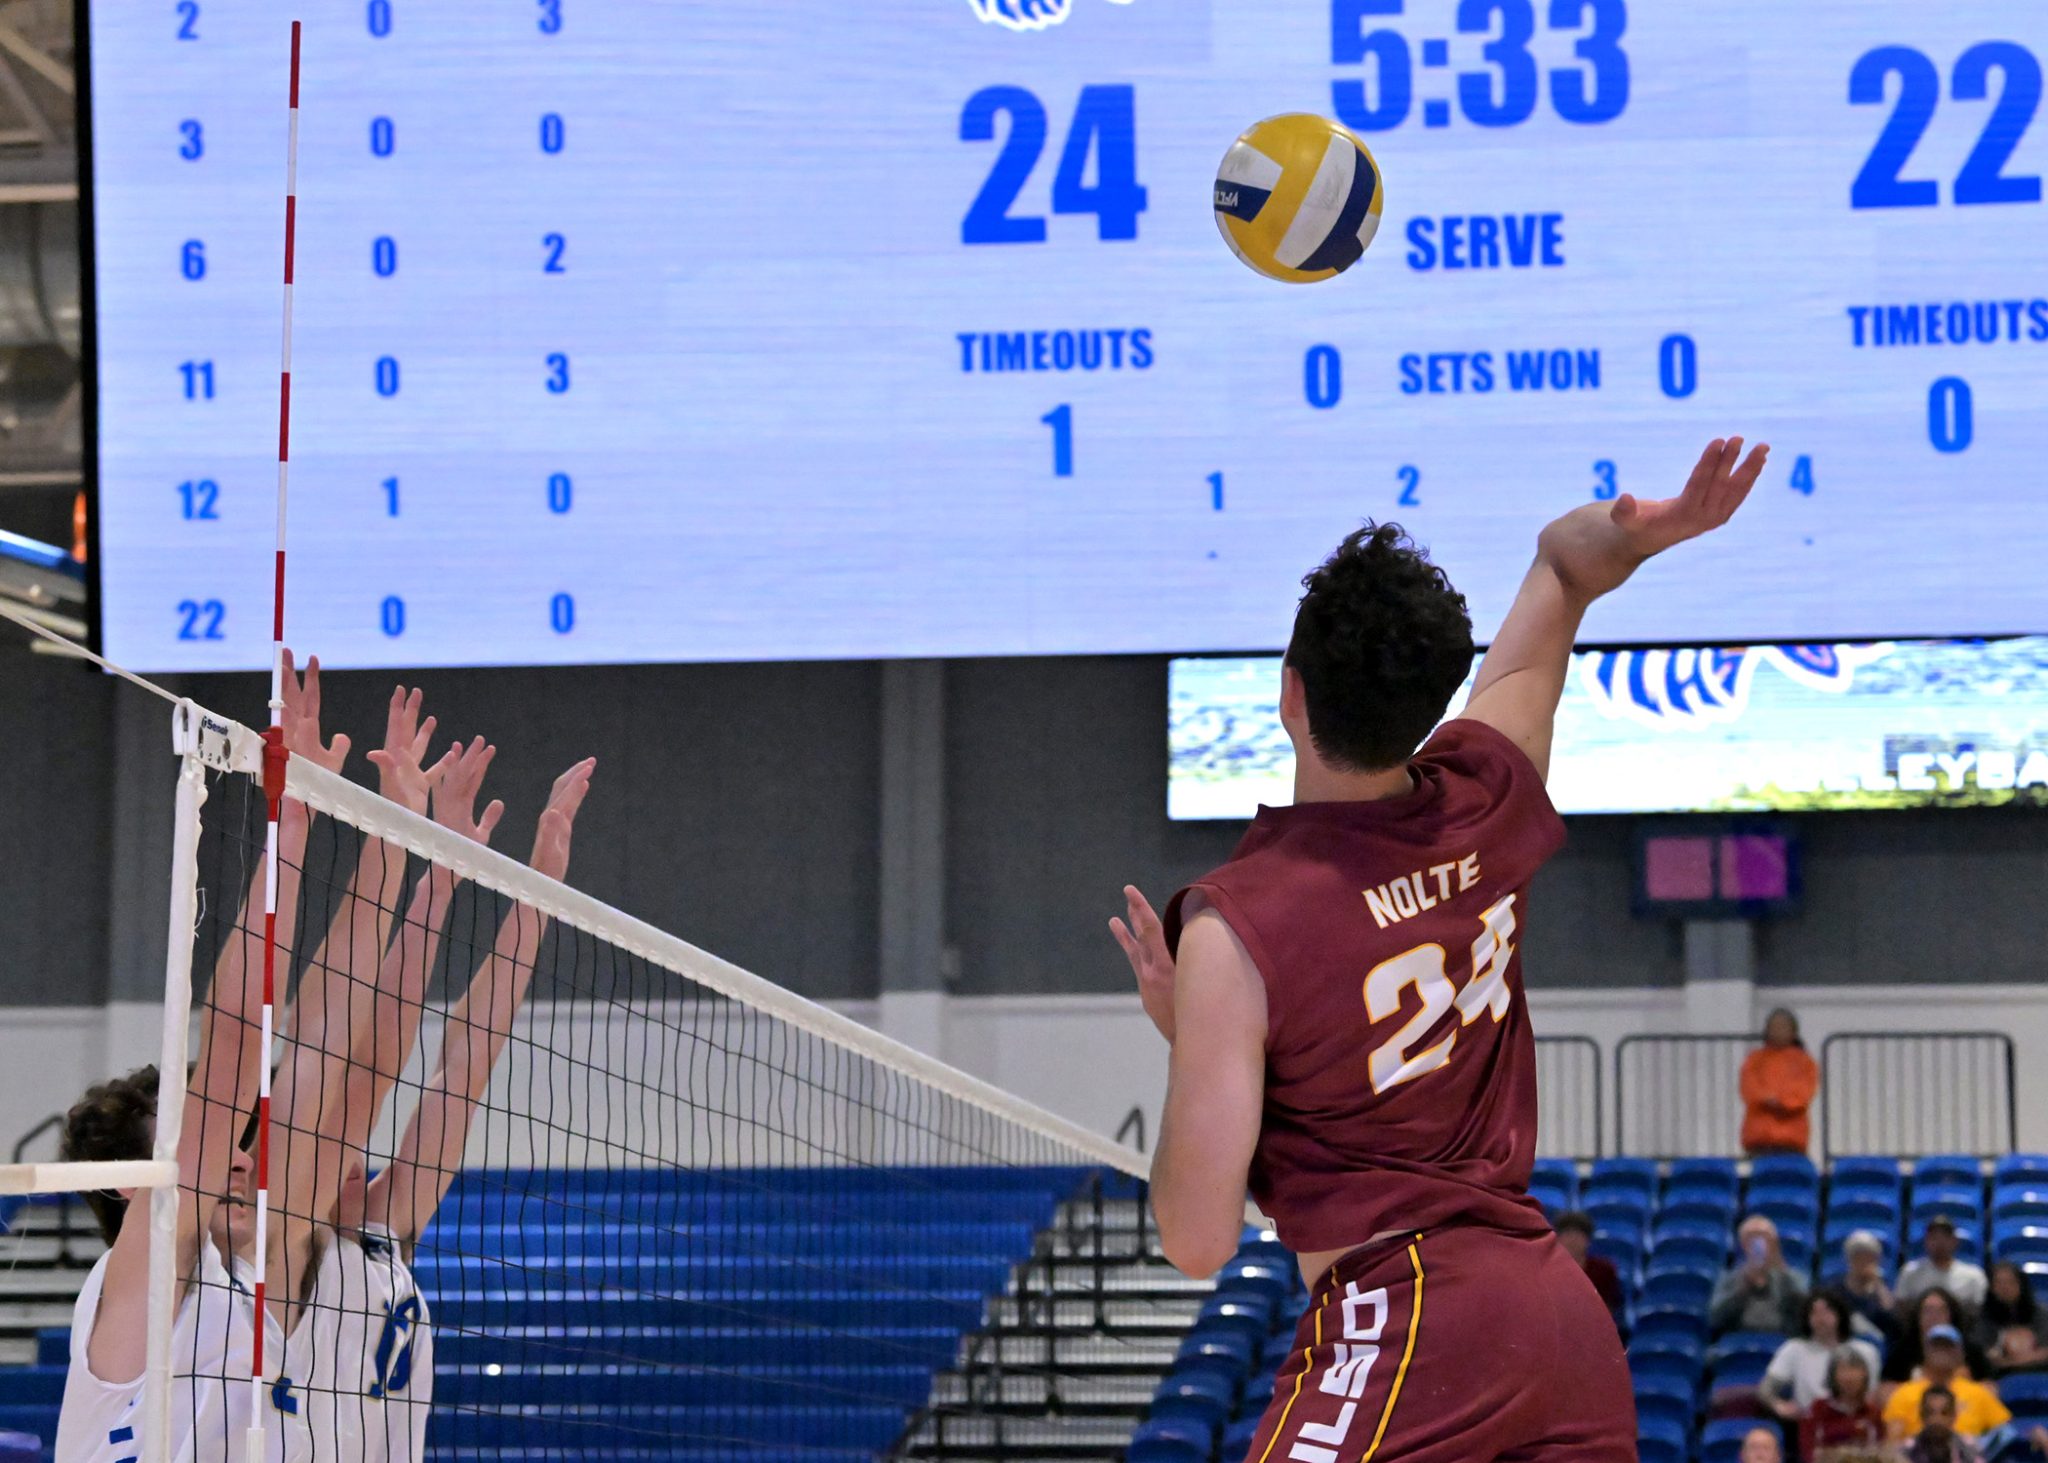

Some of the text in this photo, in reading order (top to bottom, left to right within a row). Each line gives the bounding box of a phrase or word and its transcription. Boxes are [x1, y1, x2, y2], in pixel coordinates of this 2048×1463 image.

[176, 0, 563, 41] 2 0 3
[1330, 0, 1631, 133] 5:33
[178, 112, 565, 161] 3 0 0
[1847, 40, 2044, 210] 22
[958, 83, 1149, 246] 24
[180, 232, 566, 281] 6 0 2
[1405, 212, 1565, 272] SERVE
[955, 328, 1154, 373] TIMEOUTS
[1846, 298, 2048, 348] TIMEOUTS
[178, 352, 570, 400] 11 0 3
[1303, 343, 1342, 410] 0
[1398, 348, 1601, 395] SETS WON
[1658, 332, 1698, 400] 0
[1040, 403, 1074, 478] 1
[1926, 375, 1974, 454] 0
[176, 472, 573, 521] 12 1 0
[1206, 454, 1816, 511] 1 2 3 4
[176, 592, 575, 640] 22 0 0
[1362, 850, 1482, 929] NOLTE
[1363, 892, 1516, 1095] 24
